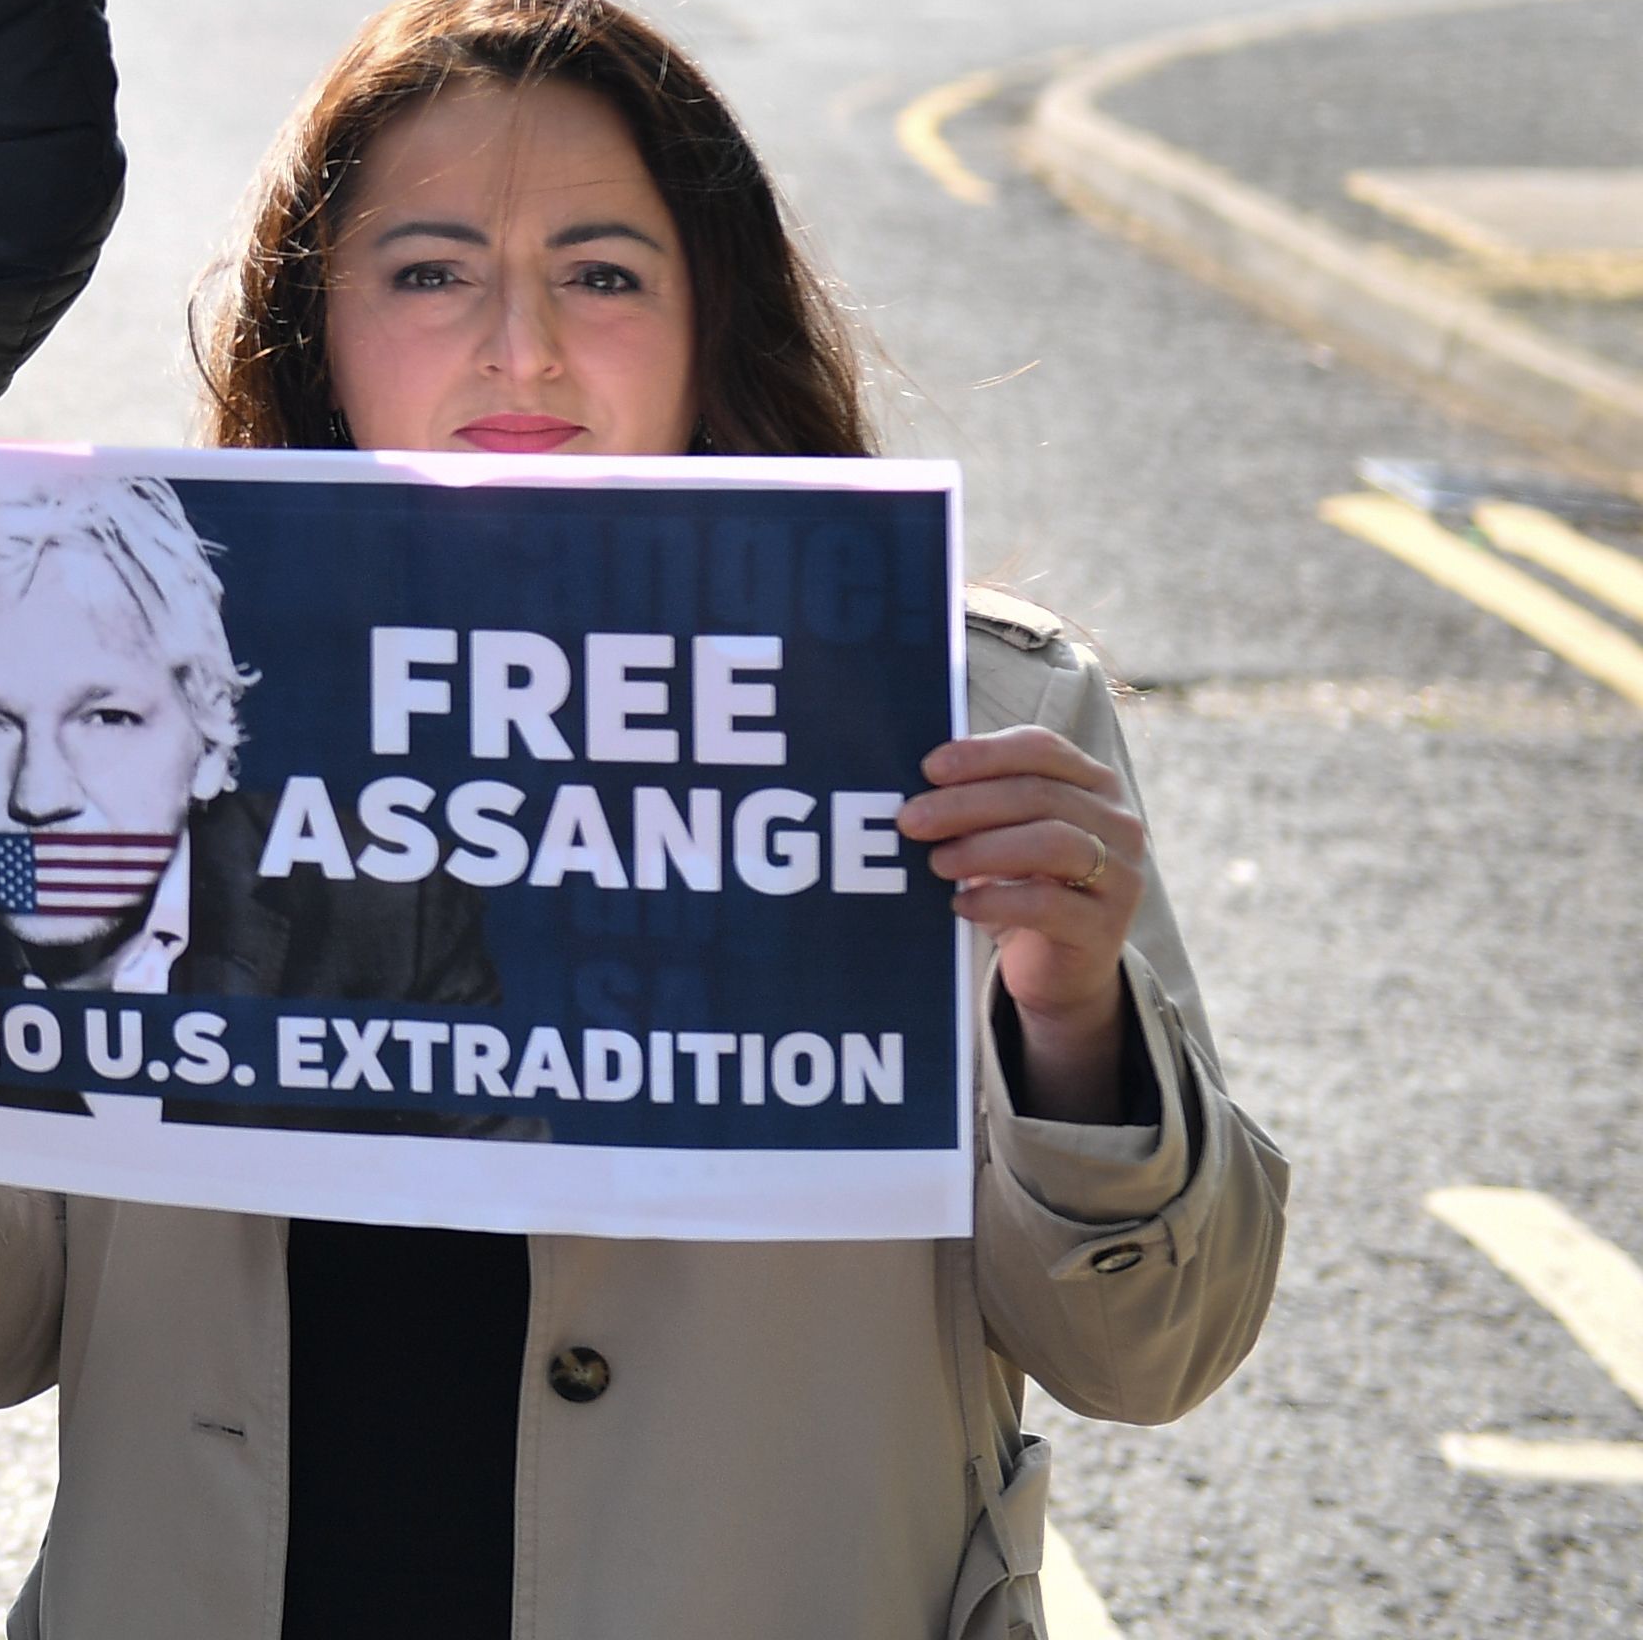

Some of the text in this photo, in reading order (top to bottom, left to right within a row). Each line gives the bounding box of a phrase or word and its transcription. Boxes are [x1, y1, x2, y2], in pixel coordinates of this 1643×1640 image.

[371, 626, 787, 766] FREE
[257, 775, 908, 896] ASSANGE
[84, 1004, 258, 1088] U.S.
[277, 1016, 905, 1107] EXTRADITION
